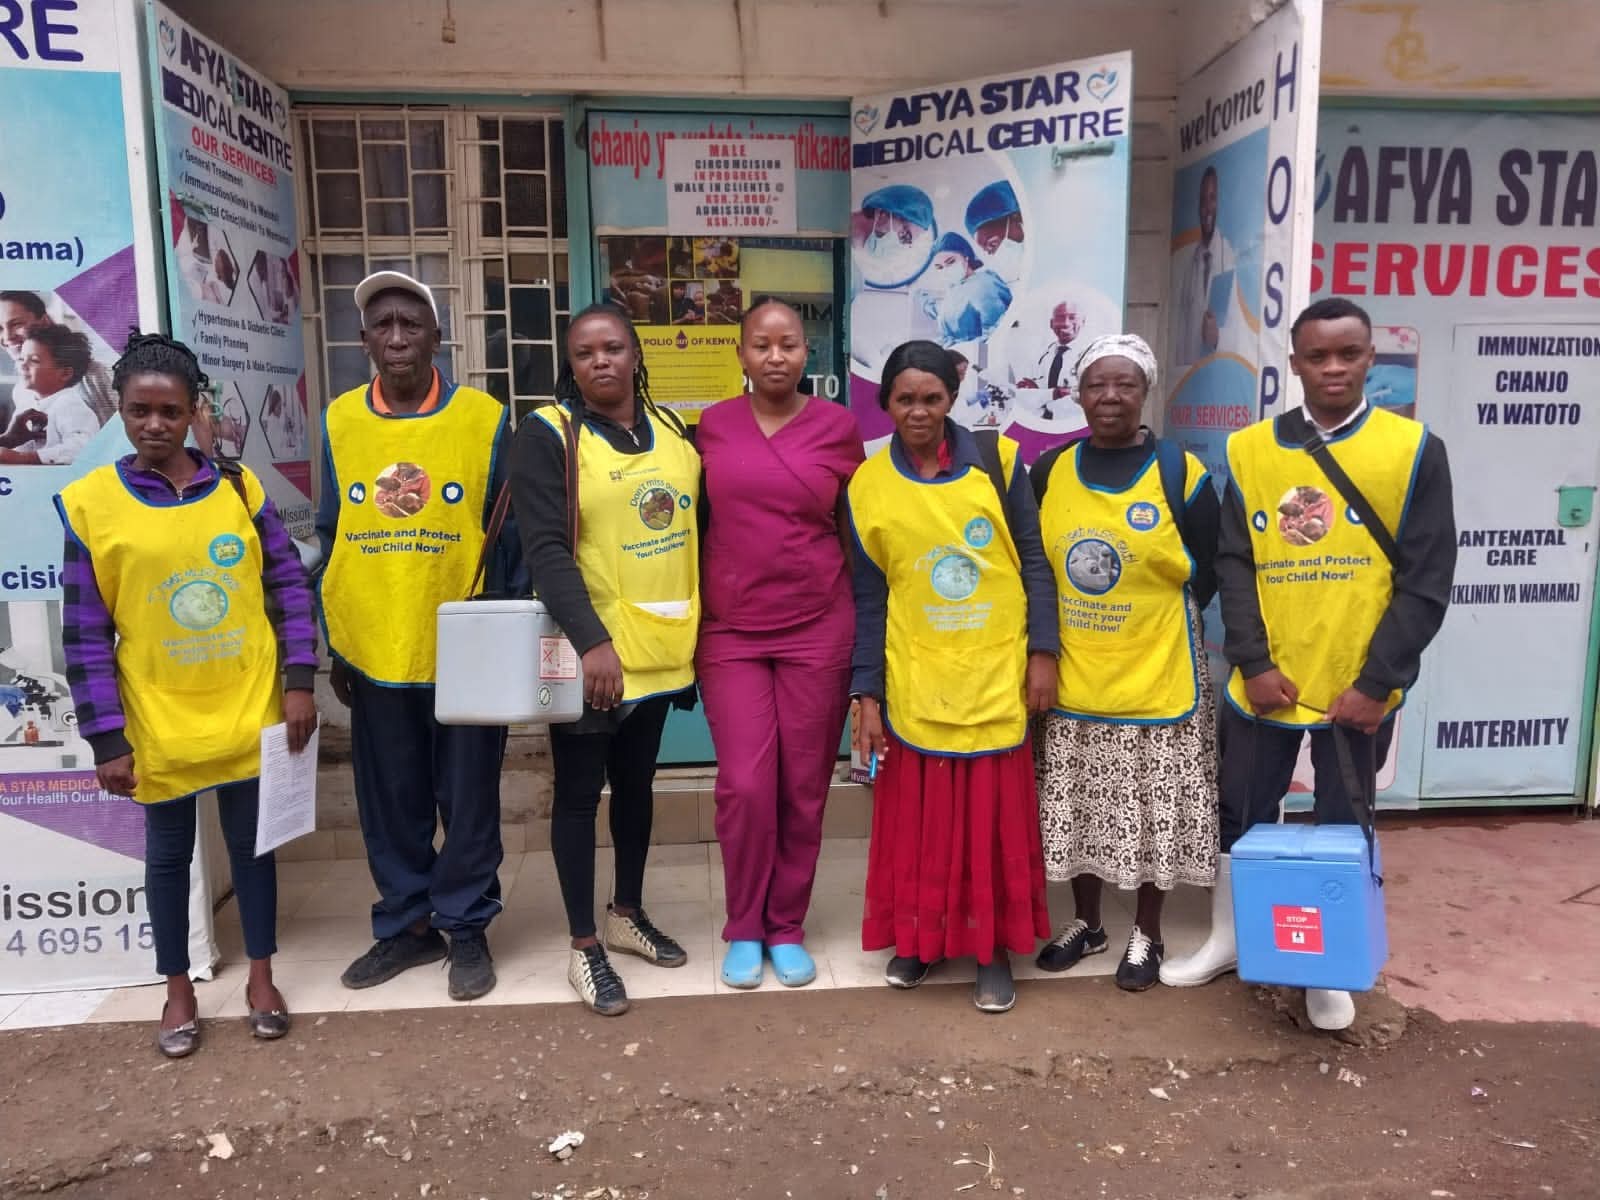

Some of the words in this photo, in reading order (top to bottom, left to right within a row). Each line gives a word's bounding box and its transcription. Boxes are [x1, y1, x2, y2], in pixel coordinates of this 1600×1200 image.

[181, 27, 233, 95] AFYA
[884, 88, 975, 129] AFYA
[981, 71, 1081, 115] STAR
[1180, 78, 1265, 151] welcome
[987, 107, 1124, 150] CENTRE
[192, 126, 219, 156] OUR
[239, 114, 293, 172] CENTRE
[591, 119, 650, 179] chanjo
[709, 144, 746, 157] MALE
[709, 171, 768, 181] PROGRESS
[1334, 146, 1472, 224] AFYA
[674, 183, 705, 192] WALK
[724, 182, 770, 192] CLIENTS
[696, 205, 760, 215] ADMISSION
[0, 236, 83, 267] ama)
[200, 331, 222, 349] Family
[644, 338, 673, 346] POLIO
[691, 338, 704, 346] OF
[706, 337, 737, 345] KENYA
[1478, 336, 1600, 357] IMMUNIZATION
[1496, 370, 1569, 393] CHANJO
[1477, 403, 1498, 425] YA
[1503, 403, 1581, 425] WATOTO
[345, 529, 391, 541] Vaccinate
[393, 528, 416, 538] and
[420, 528, 462, 542] Protect
[1458, 529, 1567, 547] ANTENATAL
[383, 542, 413, 552] Child
[415, 543, 445, 554] Now!
[621, 538, 660, 551] Vaccinate
[1298, 556, 1321, 567] and
[1325, 555, 1371, 566] Protect
[1487, 549, 1537, 567] CARE
[1287, 571, 1318, 582] Child
[1503, 583, 1517, 604] YA
[1063, 606, 1098, 621] rotect
[1101, 612, 1127, 623] your
[1110, 602, 1131, 612] and
[1093, 622, 1120, 632] now!
[1437, 718, 1569, 749] MATERNITY
[11, 780, 45, 792] STAR
[49, 778, 100, 791] MEDICA
[27, 791, 68, 806] Health
[72, 790, 95, 803] Our
[38, 925, 102, 955] 695
